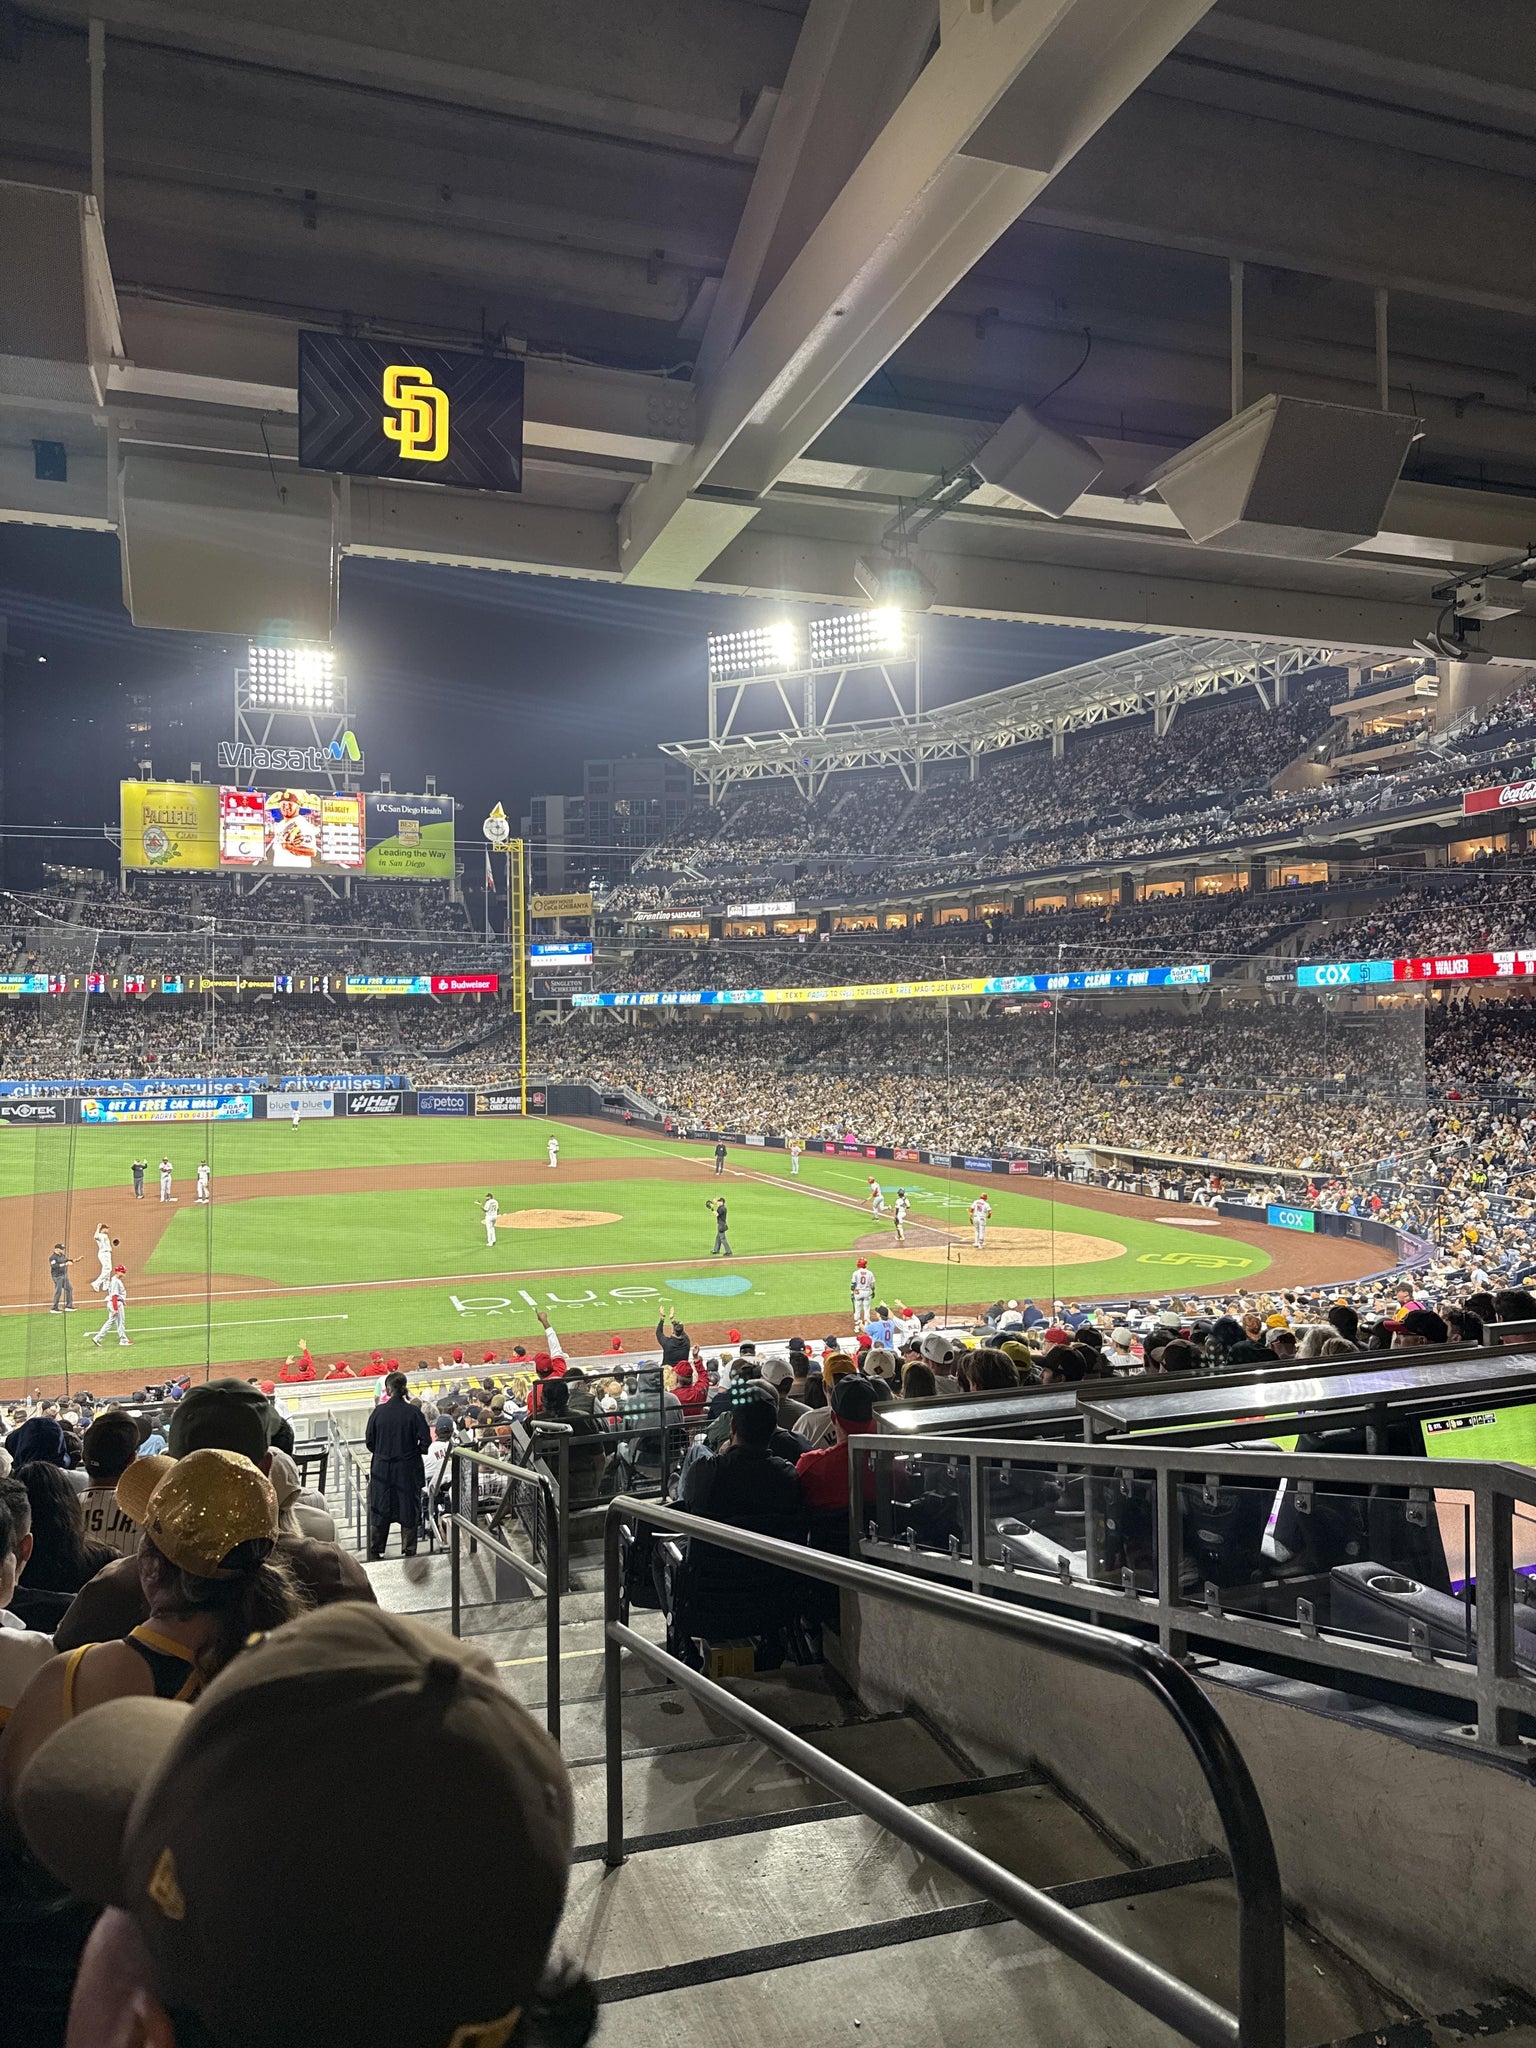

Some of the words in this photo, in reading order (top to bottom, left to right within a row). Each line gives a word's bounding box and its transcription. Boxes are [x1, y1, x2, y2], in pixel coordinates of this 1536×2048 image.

[383, 365, 450, 462] SD
[221, 741, 322, 772] Viasat
[376, 804, 388, 812] UC
[388, 804, 401, 813] San
[401, 805, 421, 815] Diego
[420, 806, 442, 815] Health
[378, 848, 412, 859] Leading
[413, 849, 428, 857] the
[429, 850, 447, 860] Way
[405, 860, 426, 869] Diego
[633, 910, 671, 921] Tarantino
[670, 911, 701, 919] SAUSAGES
[1435, 959, 1469, 975] WALKER
[1525, 961, 1535, 974] 10
[60, 974, 66, 983] 5
[136, 975, 145, 984] 12
[1085, 973, 1111, 987] CLEAN
[1315, 965, 1351, 985] COX
[60, 984, 66, 992] 7
[74, 979, 80, 988] F
[113, 979, 118, 988] F
[151, 979, 157, 988] F
[189, 979, 194, 988] F
[300, 980, 305, 989] F
[336, 980, 341, 989] F
[451, 980, 490, 989] Budweiser
[615, 995, 629, 1005] GET
[630, 995, 637, 1004] A
[639, 994, 659, 1004] FREE
[661, 994, 678, 1004] CAR
[679, 993, 702, 1003] WASH
[108, 1101, 126, 1111] GET
[128, 1101, 136, 1110] A
[139, 1099, 167, 1111] FREE
[170, 1099, 190, 1110] CAR
[191, 1099, 219, 1110] WASH
[222, 1102, 249, 1110] SOAPY
[269, 1101, 290, 1109] blue
[434, 1097, 465, 1108] petco
[1, 1104, 56, 1118] EVOTEK
[1279, 1211, 1304, 1226] COX
[860, 1276, 866, 1285] 0
[449, 1286, 661, 1311] blue
[885, 1330, 890, 1342] 0
[108, 1510, 137, 1533] JR.
